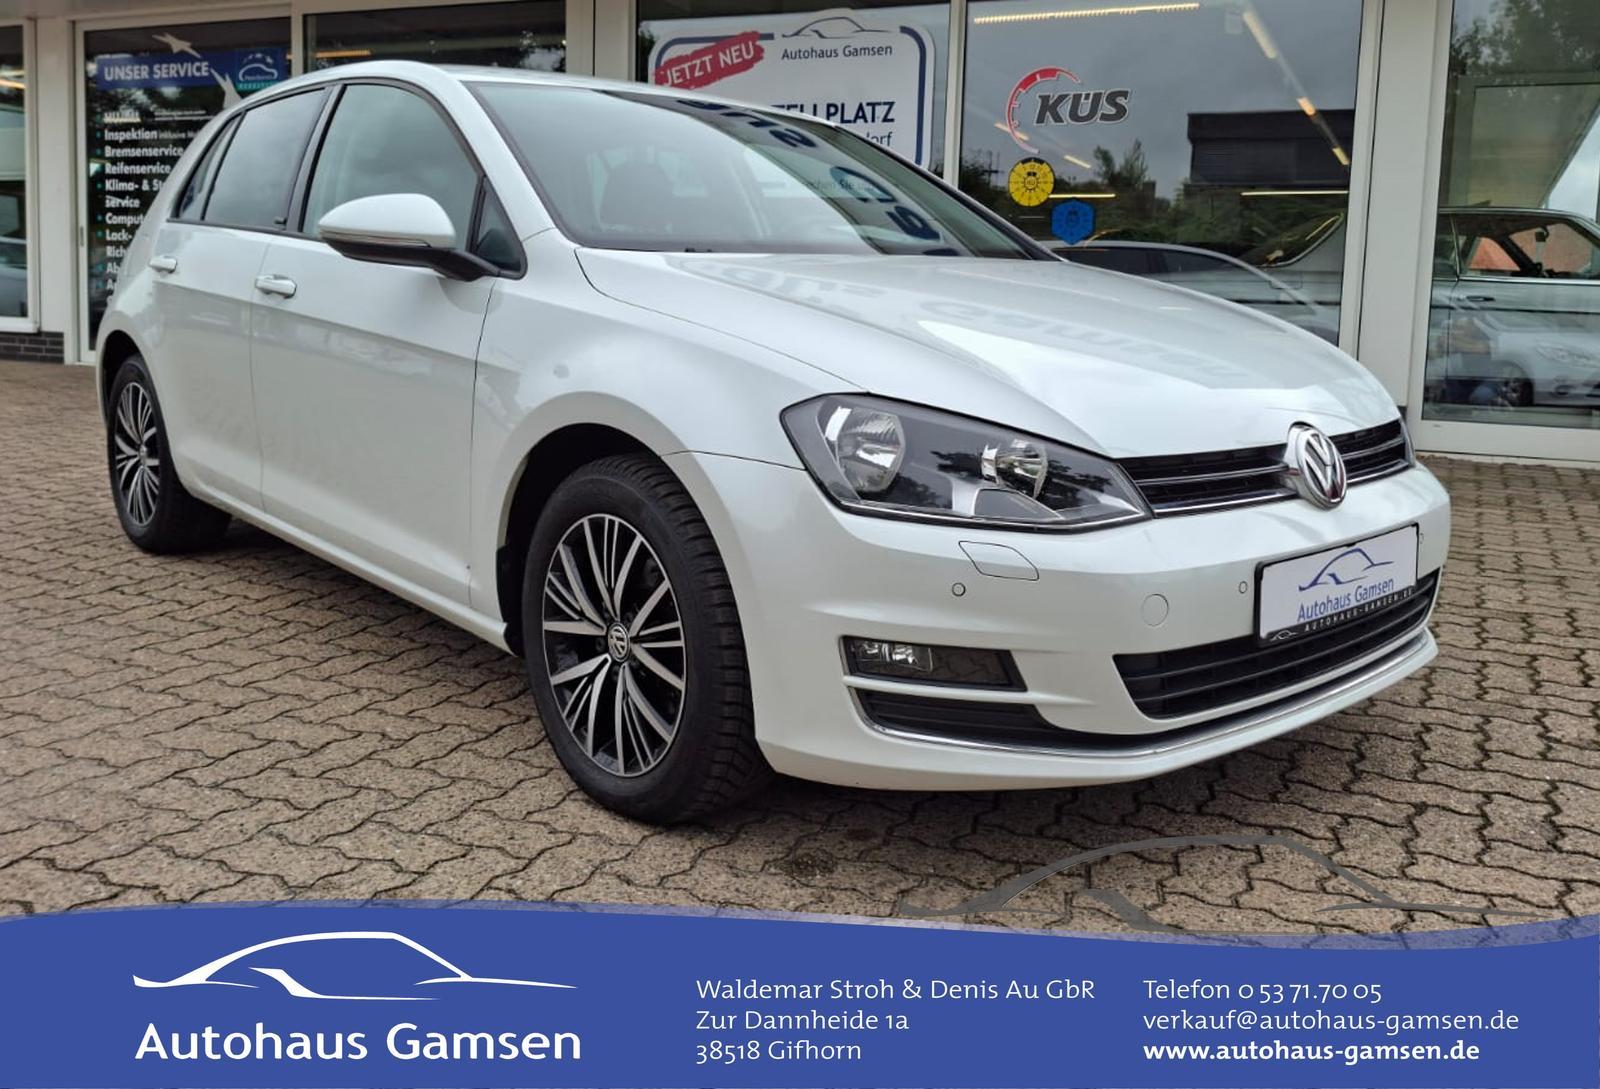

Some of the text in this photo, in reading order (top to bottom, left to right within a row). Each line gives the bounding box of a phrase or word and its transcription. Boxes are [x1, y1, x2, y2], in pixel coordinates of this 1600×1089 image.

[781, 44, 893, 60] Autohaus Gamsen
[663, 41, 755, 86] JETZT NEU
[104, 62, 210, 81] UNSER SERVICE
[1034, 89, 1130, 125] KÜS
[104, 128, 158, 143] Inspektion
[104, 144, 184, 158] Bremsenservice
[104, 161, 172, 175] Reifenservice
[105, 179, 139, 192] Klima-
[141, 179, 150, 192] &
[105, 229, 133, 241] Lack-
[1297, 578, 1394, 622] Autohaus Gamsen
